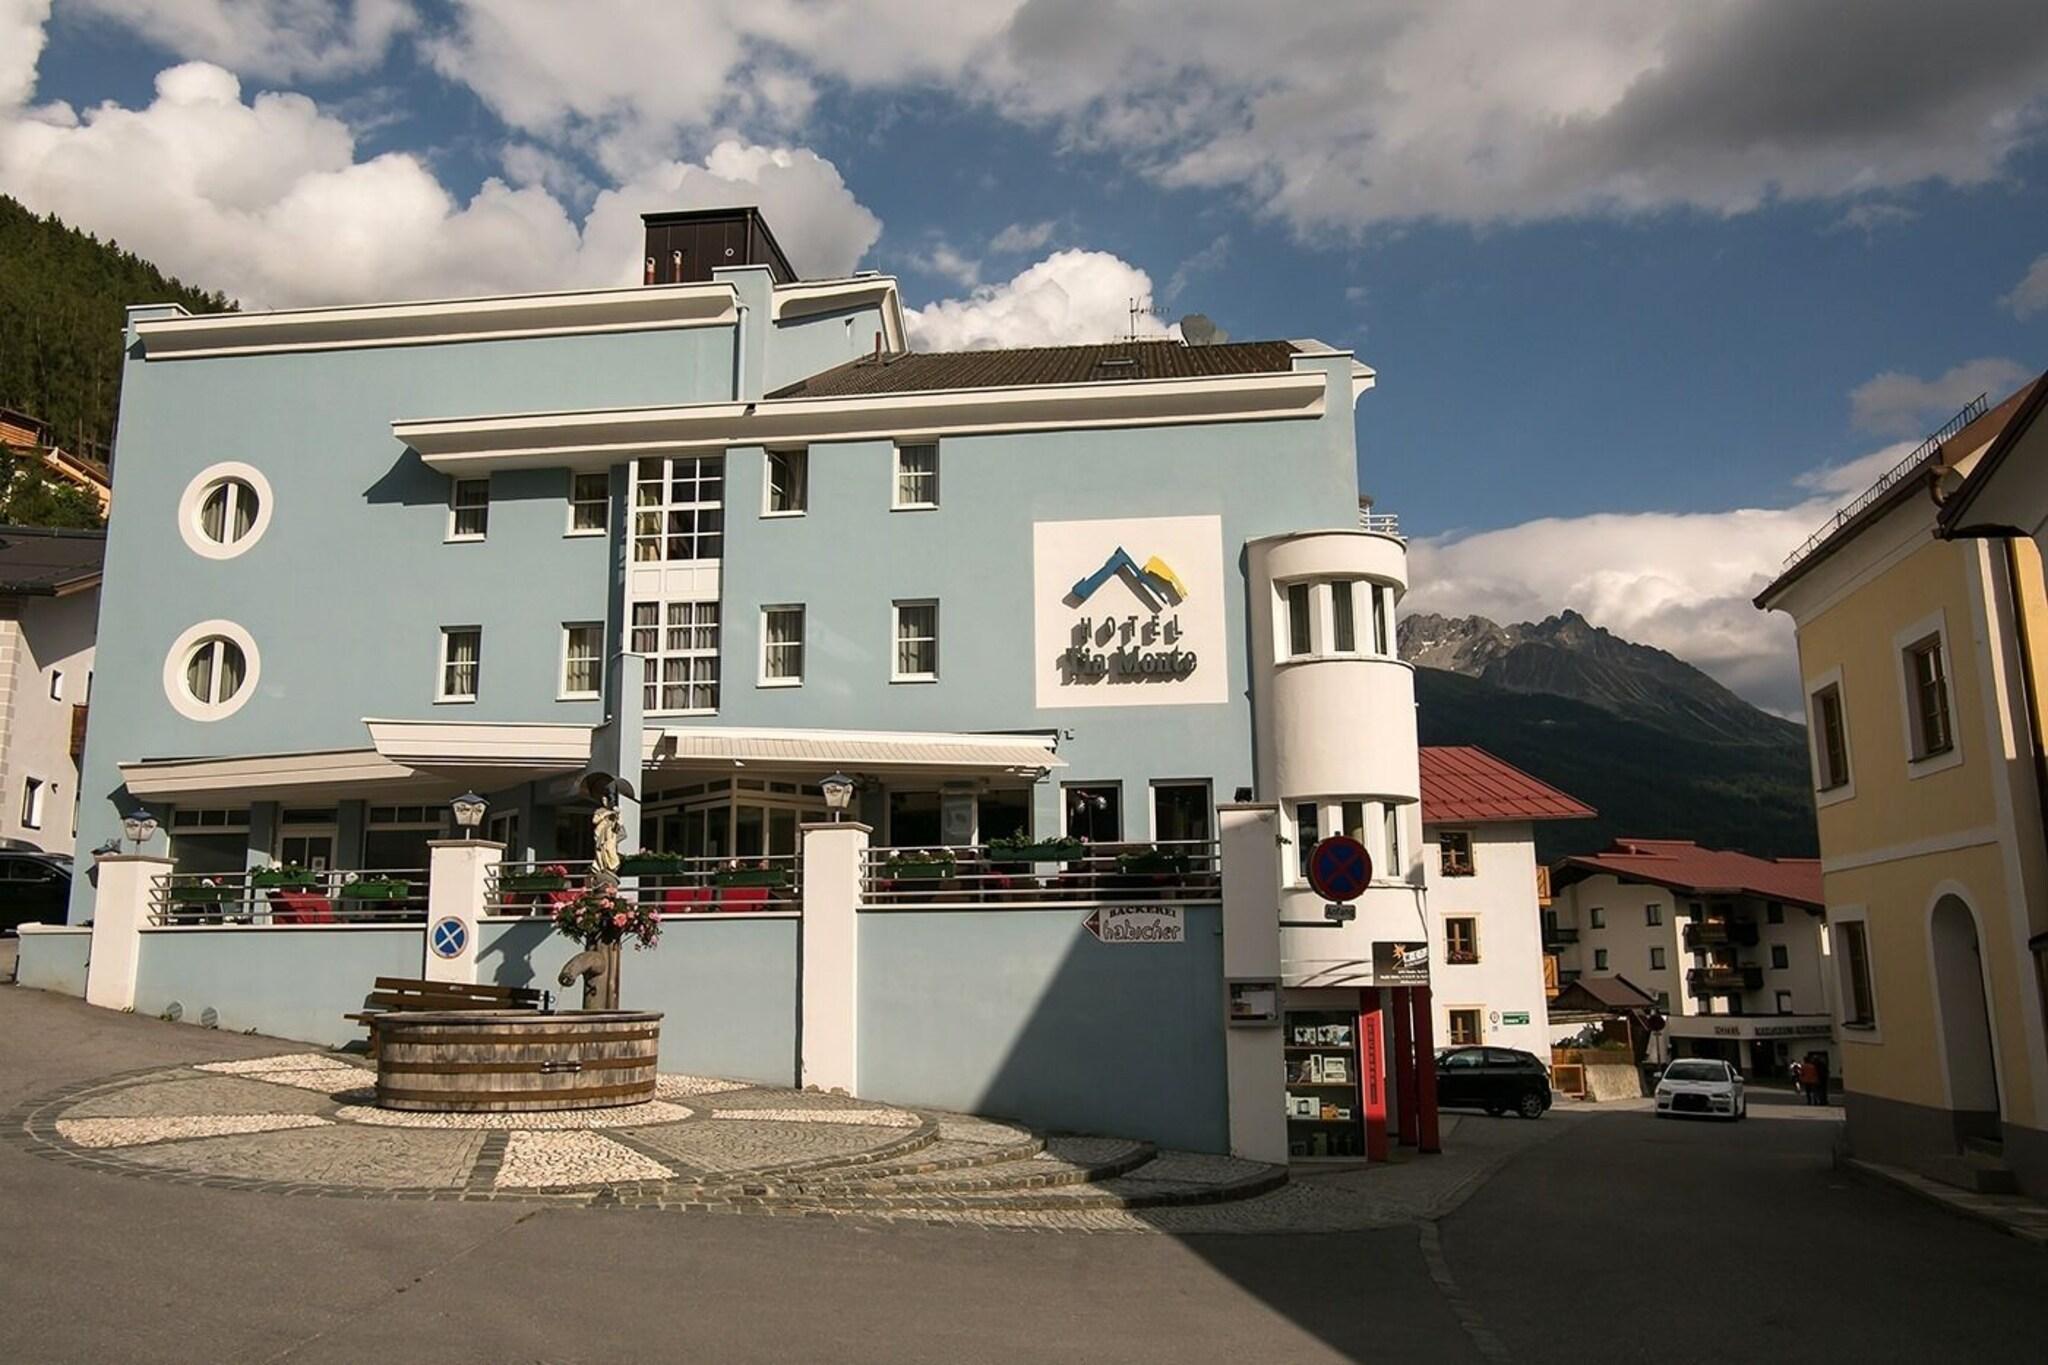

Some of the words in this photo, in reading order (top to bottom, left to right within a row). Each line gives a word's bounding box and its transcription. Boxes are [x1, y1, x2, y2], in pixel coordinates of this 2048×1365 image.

[1075, 614, 1183, 643] HOTEL
[1112, 646, 1197, 679] Monte
[1102, 918, 1181, 941] habicher
